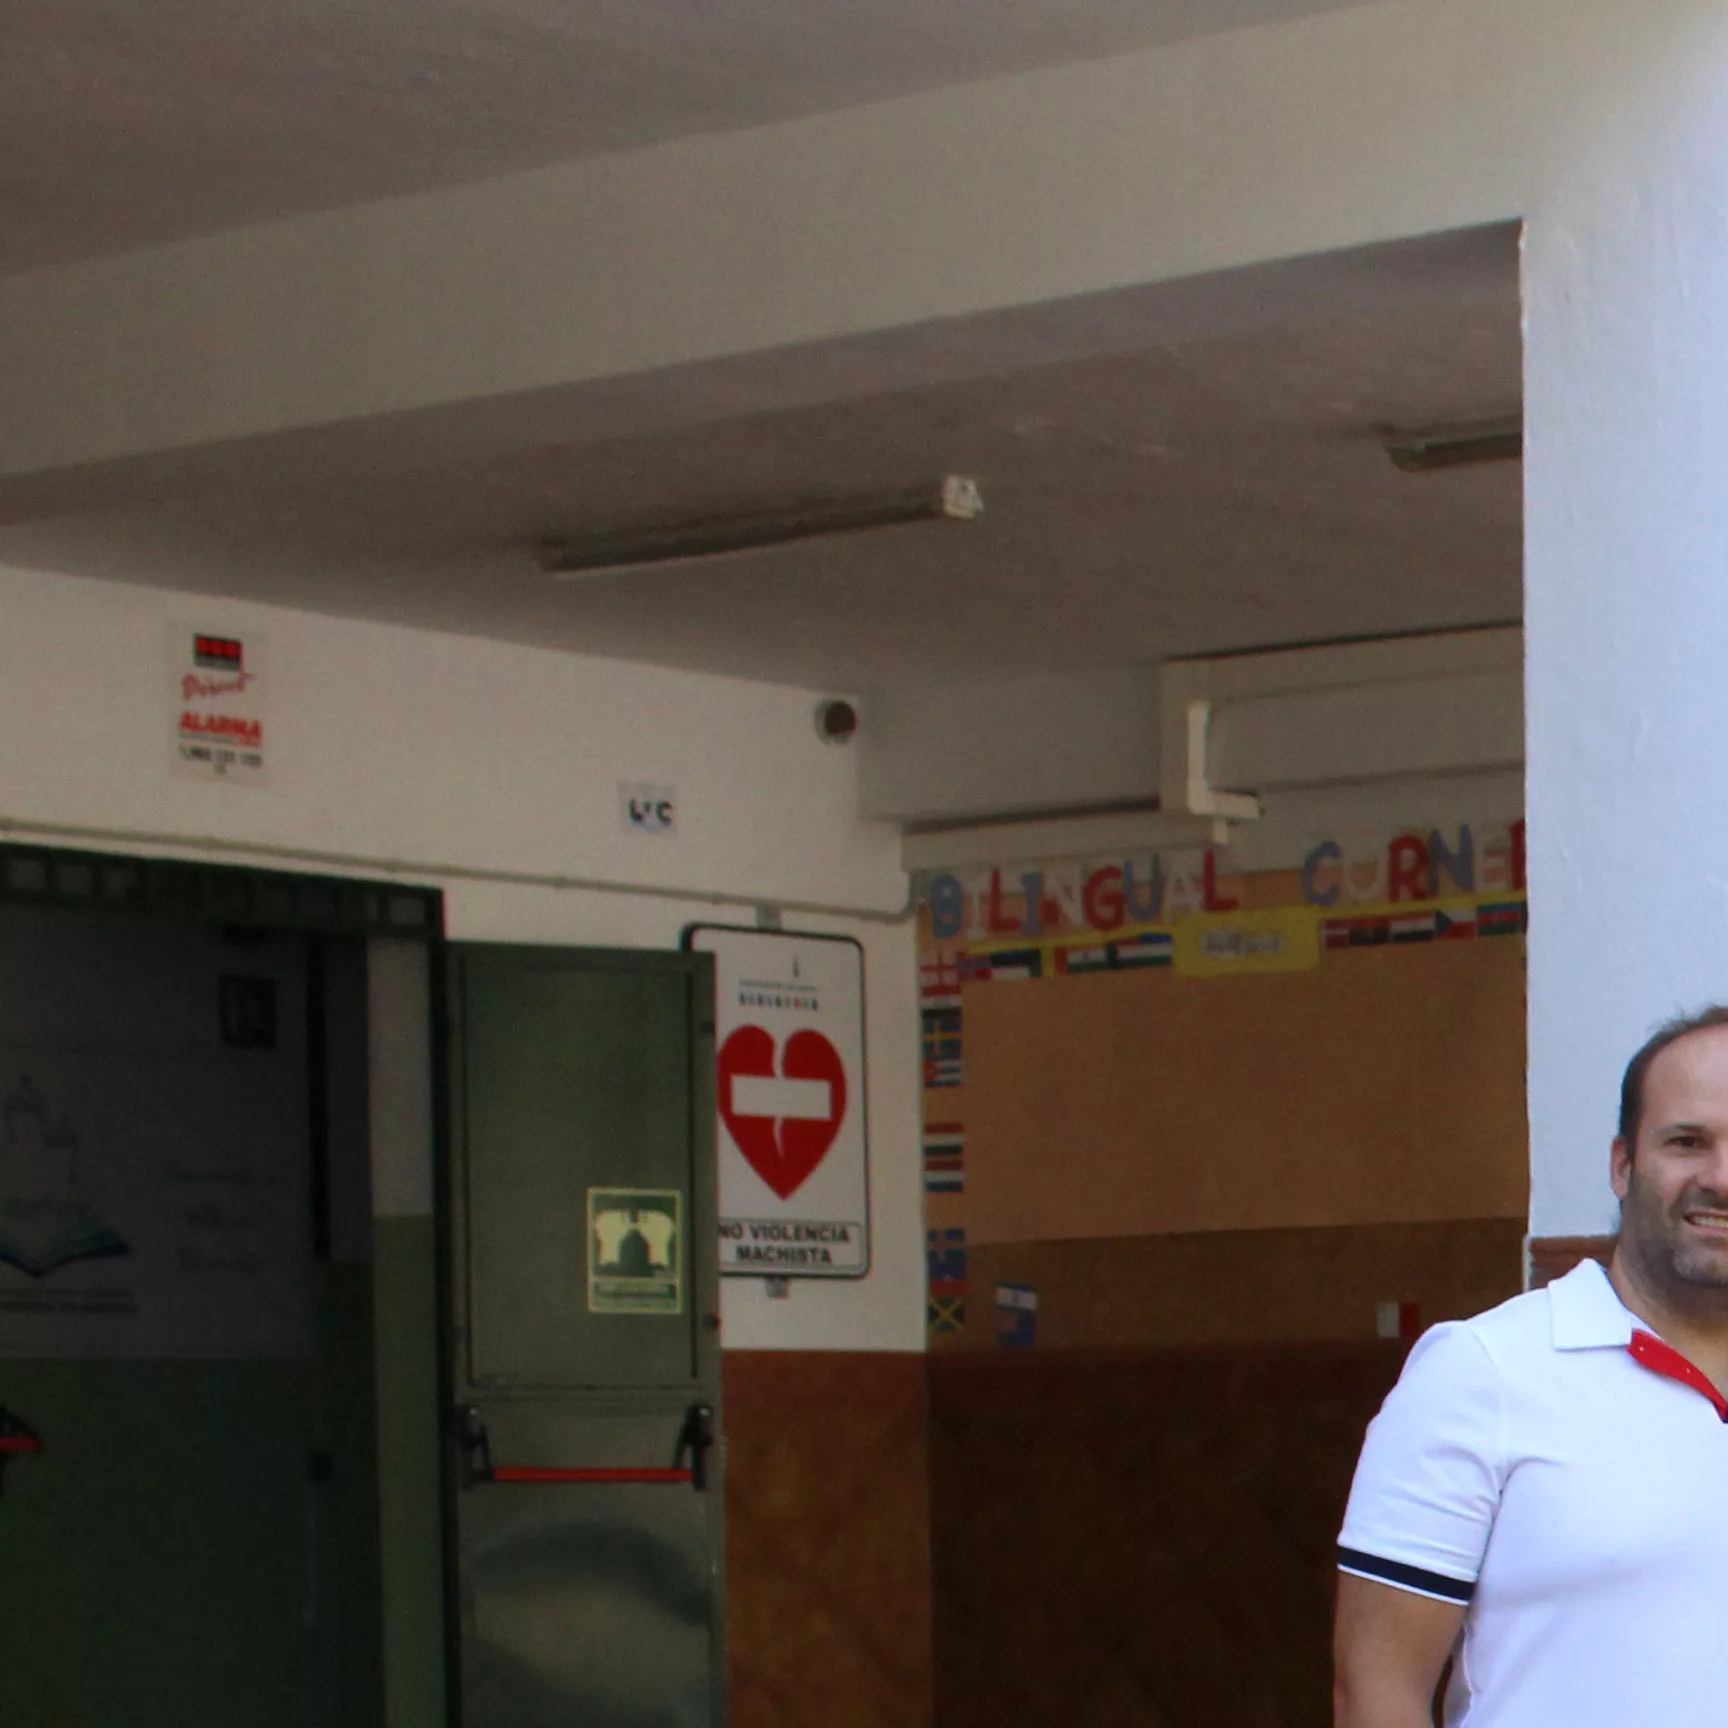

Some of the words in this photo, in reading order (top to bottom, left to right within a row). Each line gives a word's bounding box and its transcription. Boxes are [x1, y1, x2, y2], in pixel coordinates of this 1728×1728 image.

[929, 848, 1238, 940] BILINGUAL
[750, 1222, 849, 1244] VIOLENCIA
[736, 1244, 832, 1264] MACHISTA
